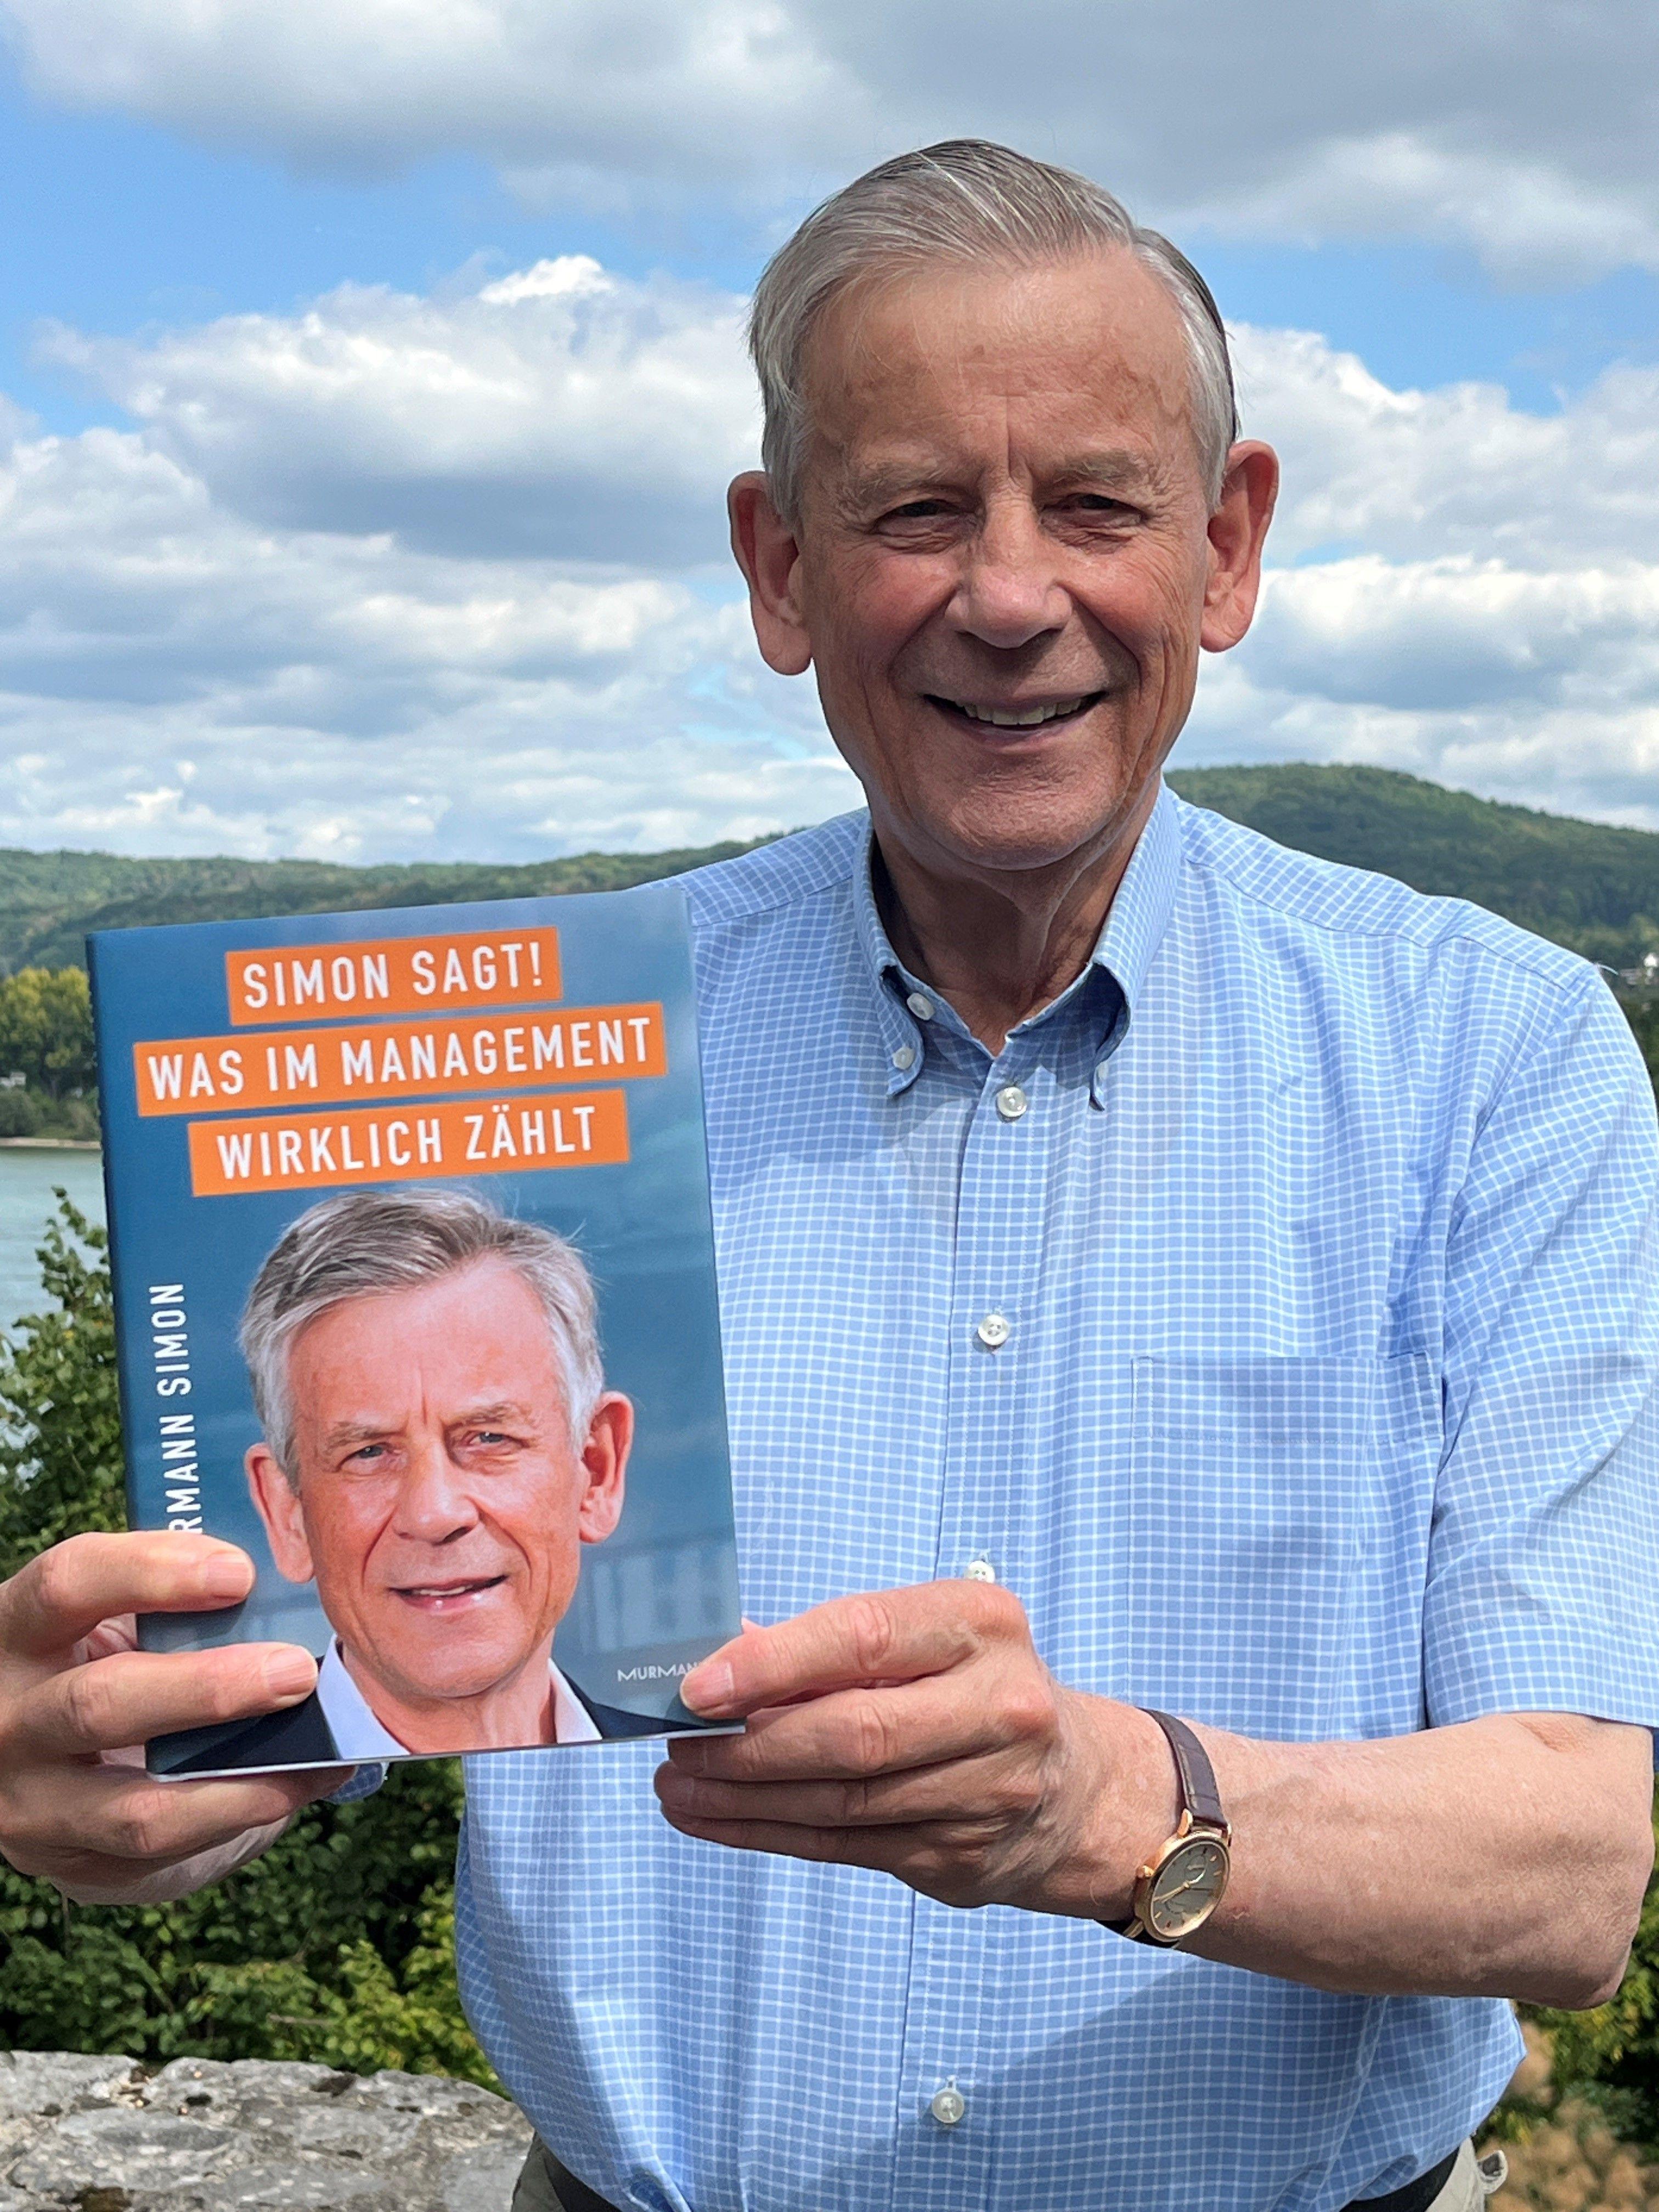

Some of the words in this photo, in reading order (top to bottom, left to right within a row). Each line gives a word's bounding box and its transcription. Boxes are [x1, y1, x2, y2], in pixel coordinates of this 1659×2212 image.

[243, 953, 390, 1009] SIMON
[411, 941, 542, 996] SAGT!
[148, 1049, 244, 1101] WAS
[266, 1043, 318, 1092] IM
[341, 1017, 650, 1086] MANAGEMENT
[216, 1118, 443, 1180] WIRKLICH
[464, 1103, 595, 1161] ZÄHLT
[149, 1284, 191, 1397] SIMON
[159, 1414, 202, 1534] RMANN
[617, 1661, 698, 1682] MURMAN
